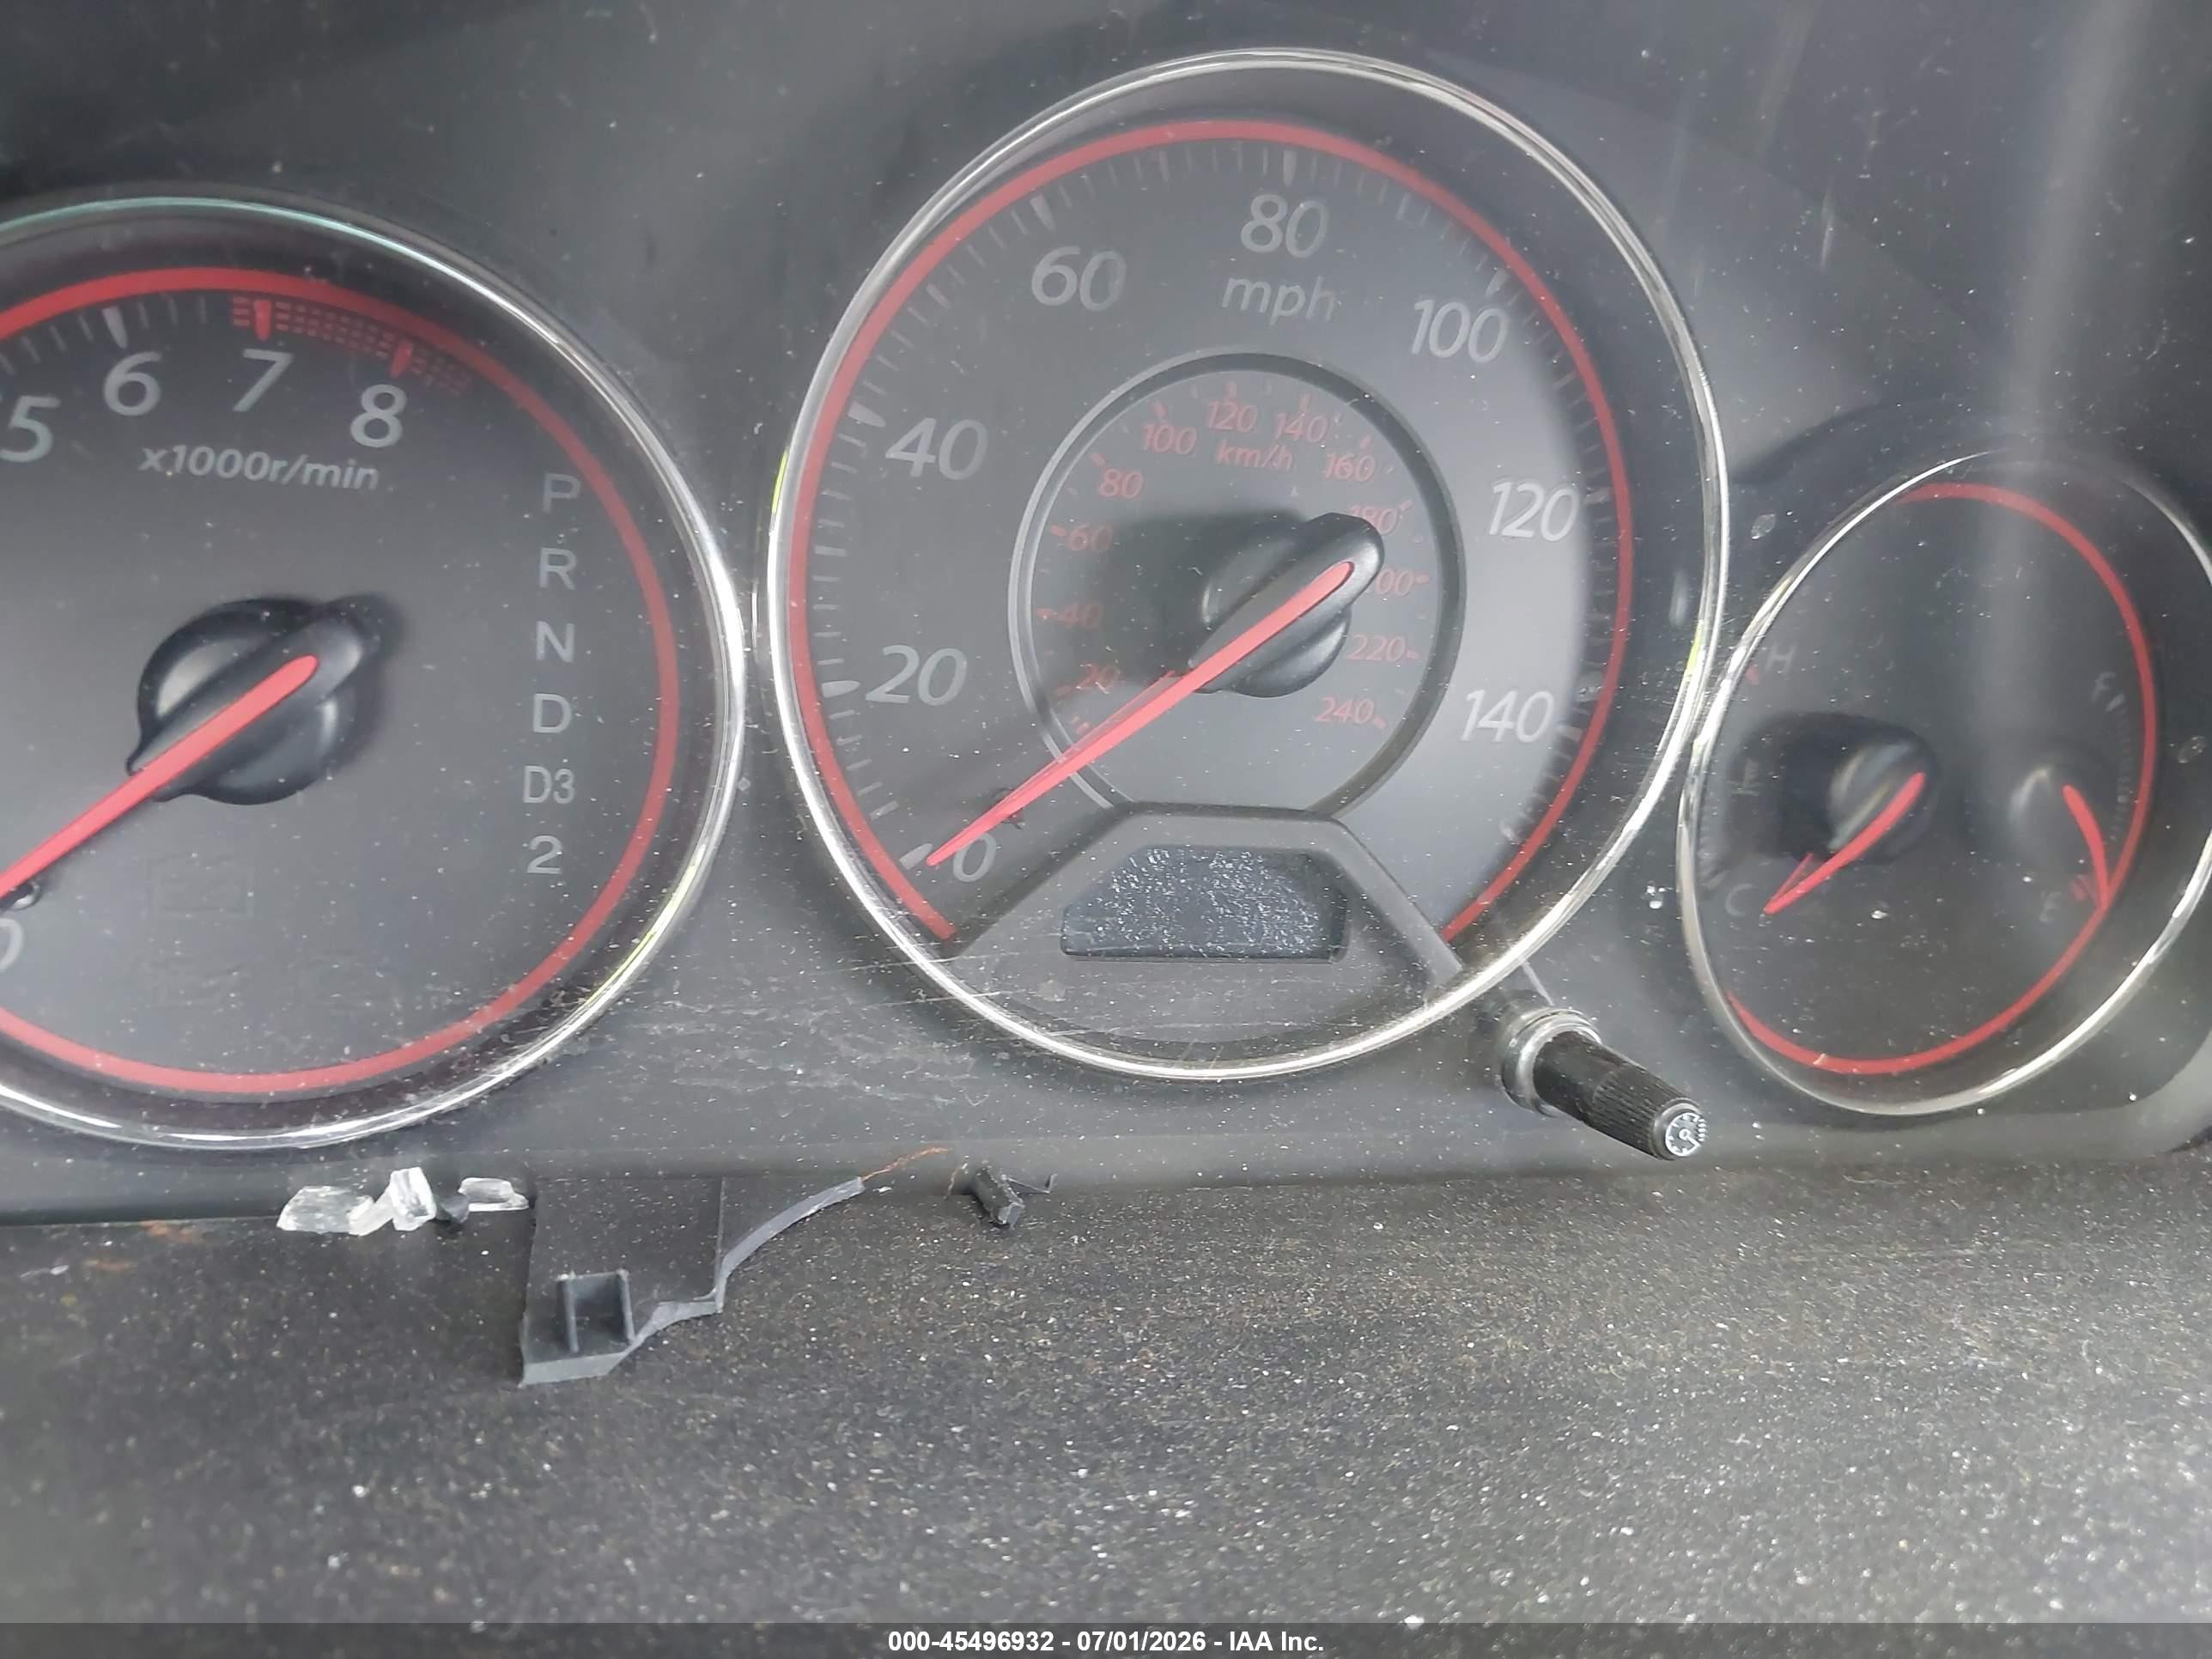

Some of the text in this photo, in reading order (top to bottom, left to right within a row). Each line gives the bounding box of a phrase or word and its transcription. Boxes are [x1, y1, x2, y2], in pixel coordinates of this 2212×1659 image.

[1240, 195, 1329, 258] 80
[1031, 246, 1126, 311] 60
[1221, 277, 1337, 326] mph
[1410, 299, 1509, 363] 100
[103, 351, 162, 416] 6
[233, 349, 294, 412] 7
[0, 395, 61, 462] 5
[350, 384, 407, 447] 8
[1207, 401, 1258, 433] 120
[1274, 413, 1328, 443] 140
[885, 417, 988, 481] 40
[1143, 423, 1197, 455] 100
[1215, 440, 1293, 471] km/h
[138, 444, 379, 490] x1000r/min
[1098, 469, 1143, 498] 80
[1322, 452, 1376, 482] 160
[544, 474, 580, 513] P
[1488, 482, 1578, 543] 120
[1066, 526, 1113, 551] 60
[539, 547, 576, 590] R
[1368, 568, 1414, 597] 00
[1052, 604, 1103, 629] 40
[538, 623, 574, 661] N
[1347, 635, 1404, 661] 220
[1765, 646, 1796, 673] H
[865, 644, 967, 706] 20
[533, 695, 571, 732] D
[1313, 697, 1374, 724] 240
[1462, 690, 1557, 744] 140
[523, 767, 575, 804] D3
[526, 836, 562, 874] 2
[952, 830, 997, 882] 0
[1724, 884, 1757, 917] C
